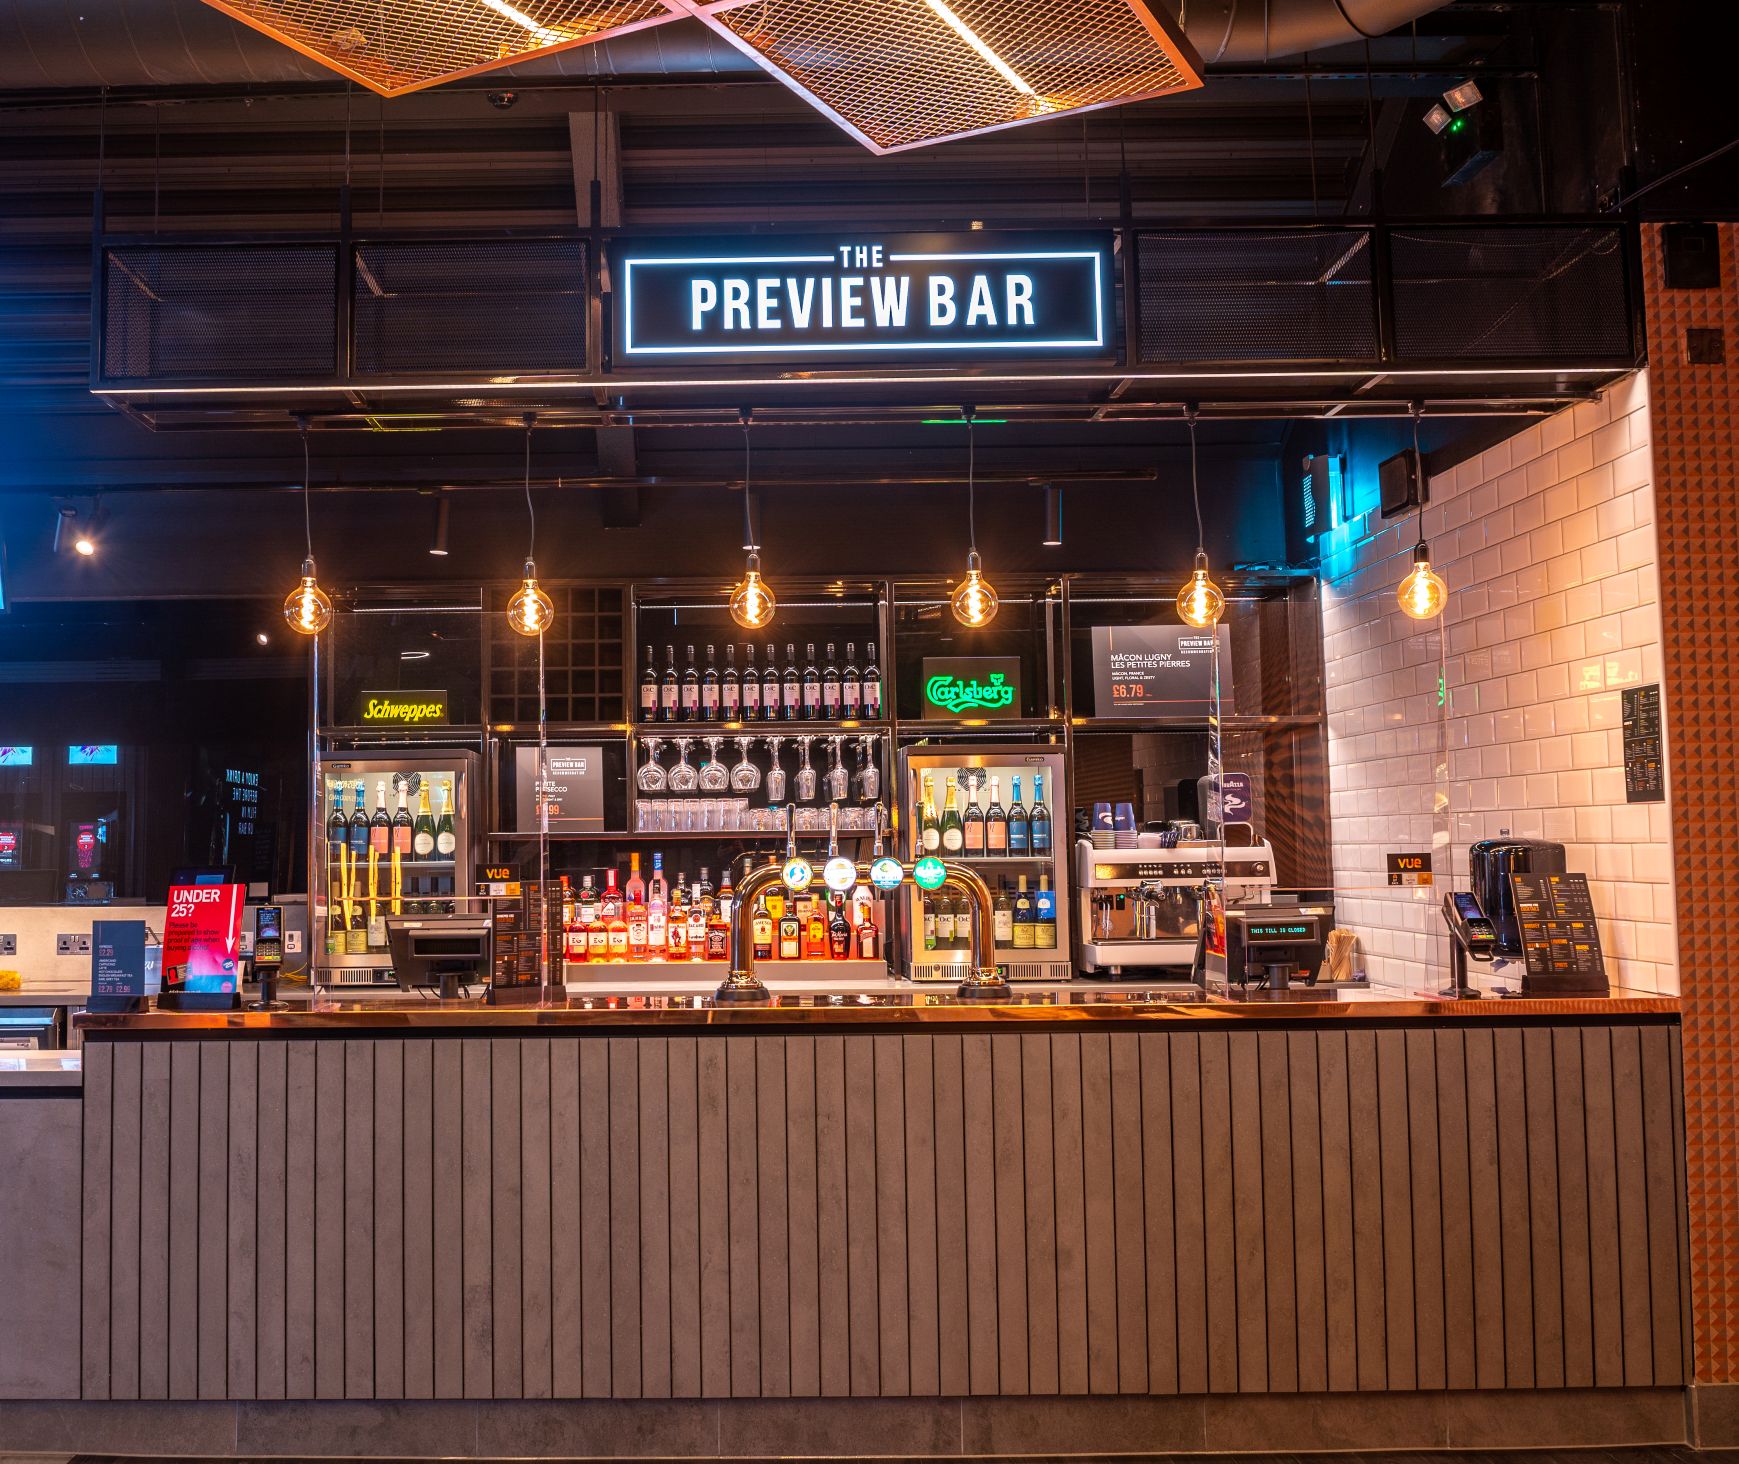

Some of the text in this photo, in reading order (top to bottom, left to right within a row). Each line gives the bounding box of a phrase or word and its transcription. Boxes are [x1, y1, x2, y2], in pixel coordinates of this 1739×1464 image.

[840, 246, 883, 267] THE
[691, 274, 1035, 330] PREVIEW BAR
[1144, 653, 1172, 661] LUGNY
[1159, 660, 1191, 668] PIERRES
[926, 674, 1014, 713] Carlsberg
[1113, 684, 1144, 697] £6.79
[364, 699, 443, 722] Schweppes
[173, 889, 220, 903] UNDER
[171, 904, 195, 917] 25?
